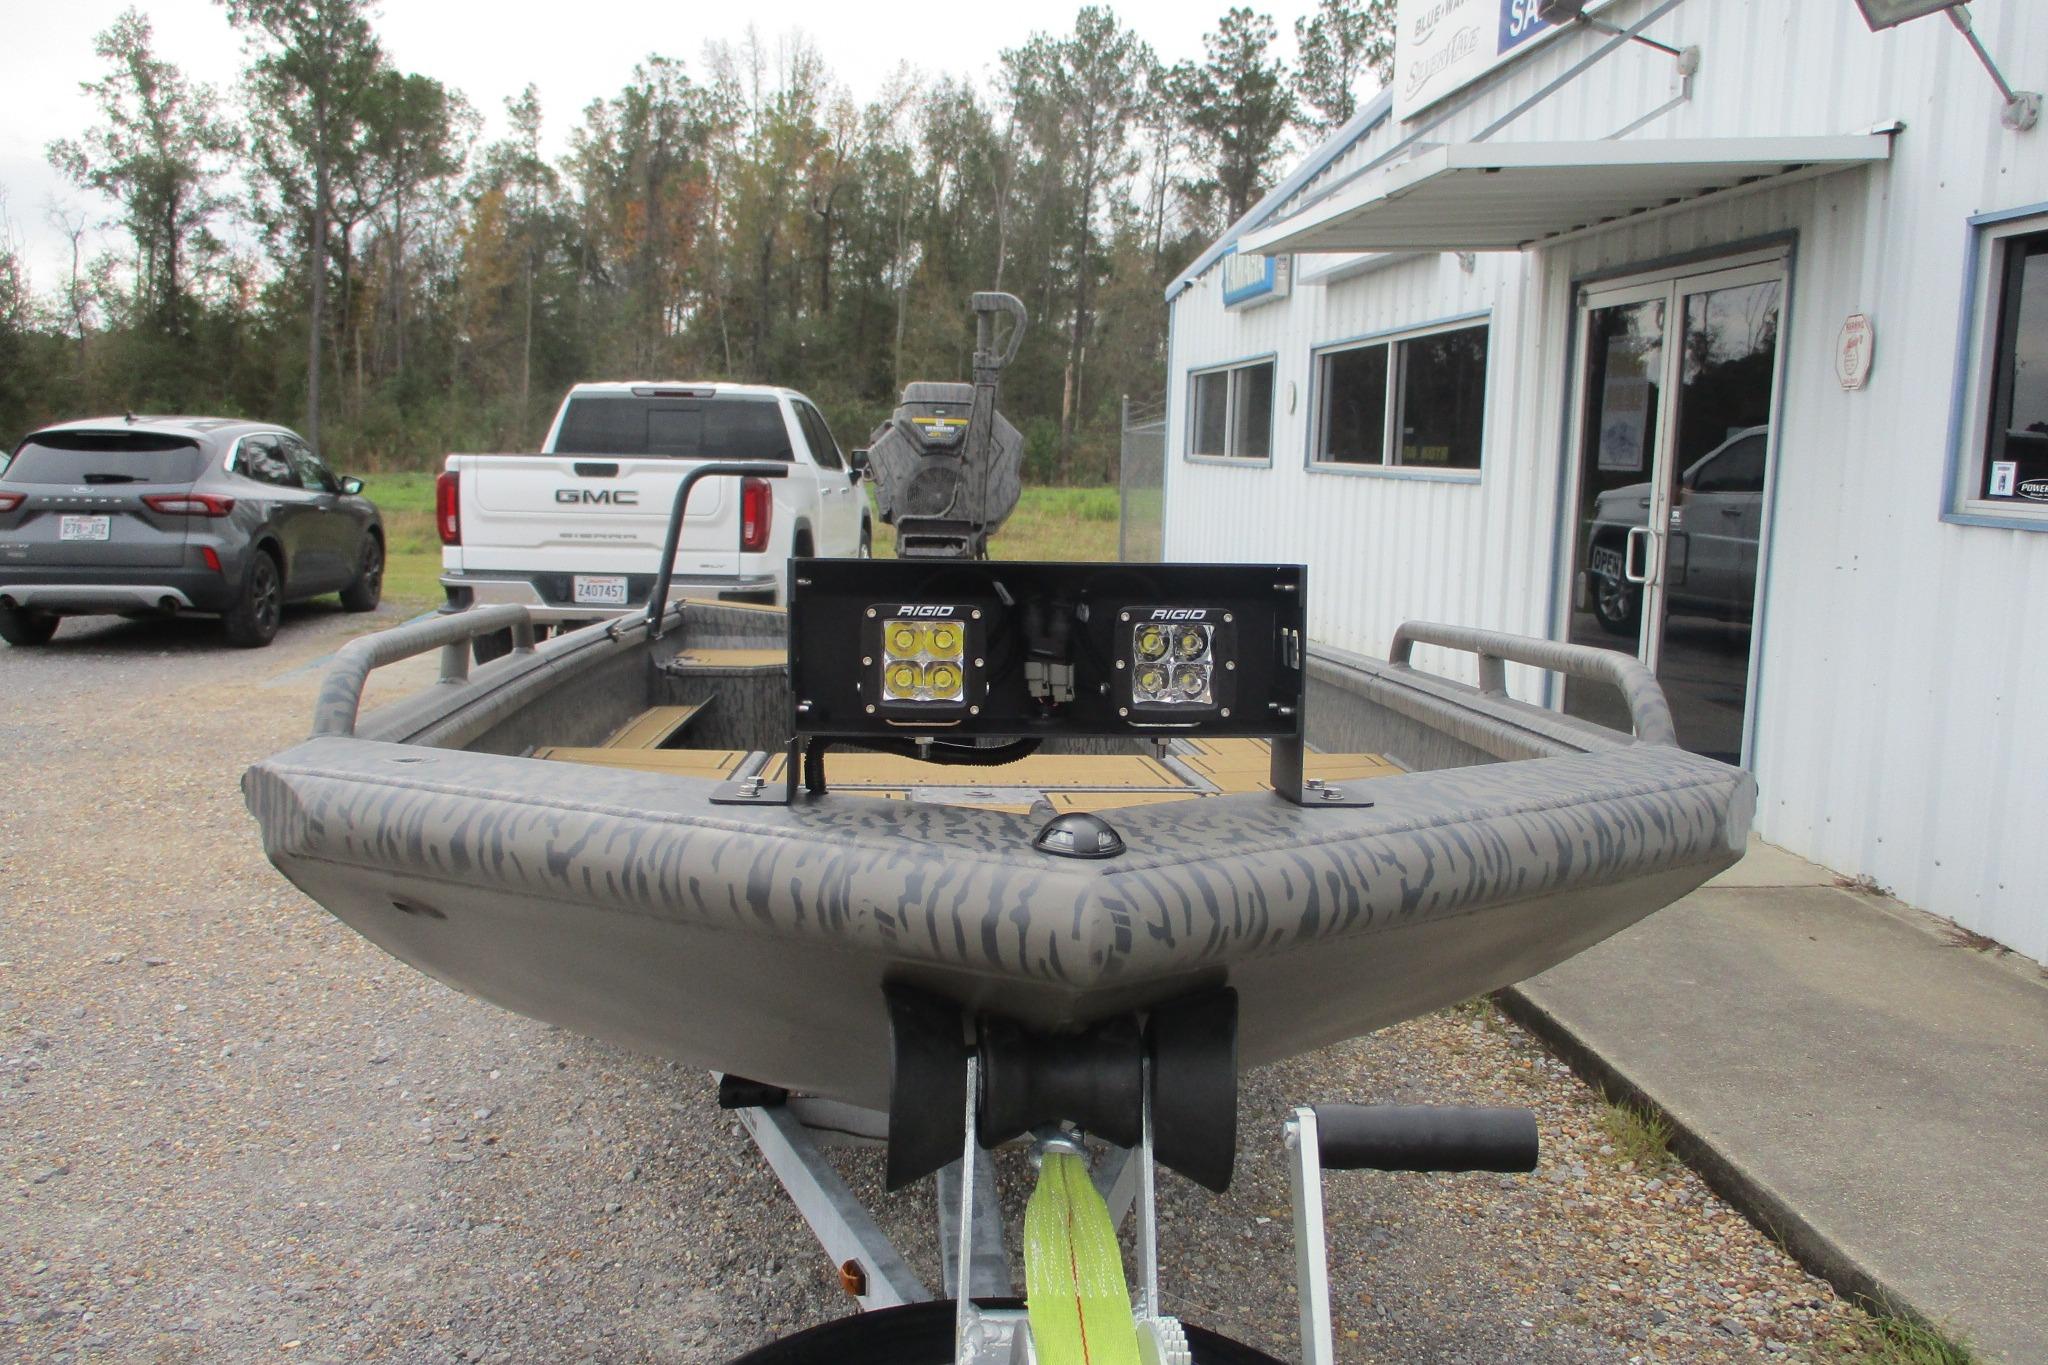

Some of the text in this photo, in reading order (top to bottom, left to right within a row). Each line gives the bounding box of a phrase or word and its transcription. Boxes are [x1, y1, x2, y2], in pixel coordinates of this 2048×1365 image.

[1415, 3, 1441, 37] BLUE
[1509, 0, 1542, 37] SA
[555, 489, 639, 506] GMC
[1594, 550, 1619, 577] OPEN
[897, 605, 955, 618] RIGID
[1150, 609, 1207, 621] RIGID
